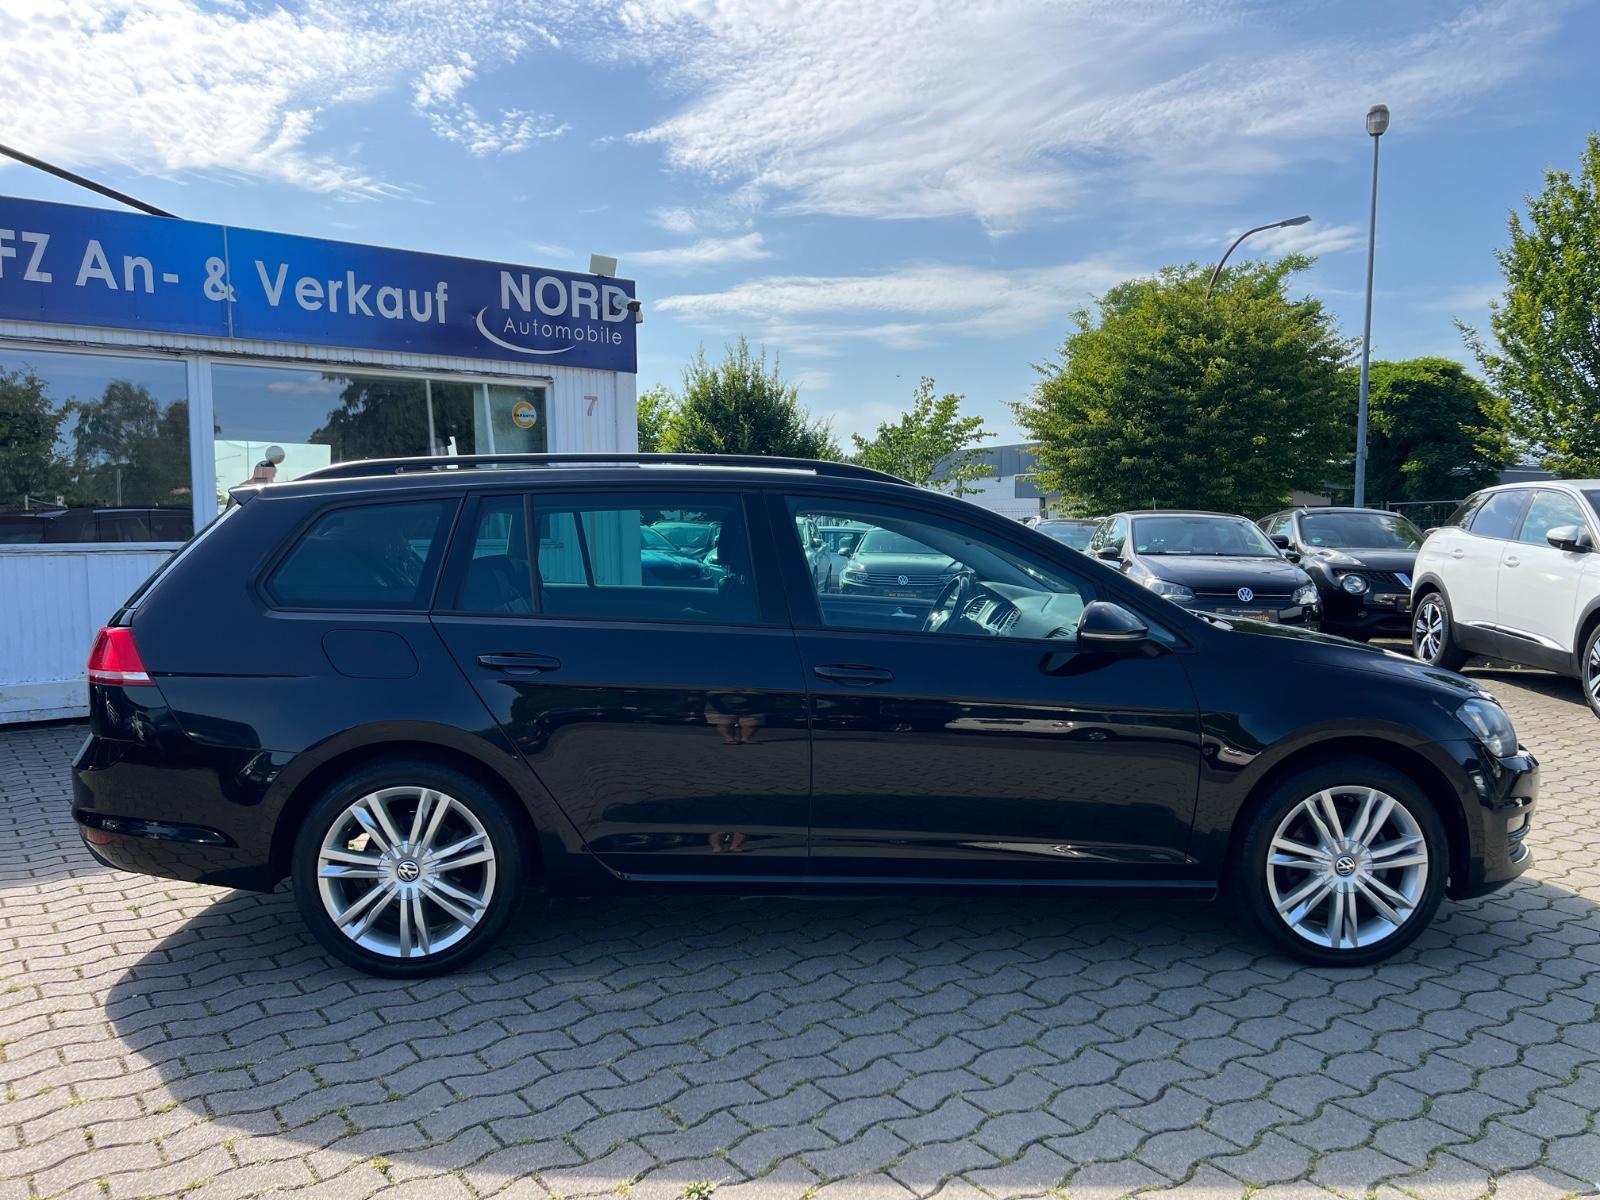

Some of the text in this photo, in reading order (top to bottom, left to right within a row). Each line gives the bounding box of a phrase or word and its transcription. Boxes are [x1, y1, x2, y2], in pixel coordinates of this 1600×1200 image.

[75, 239, 179, 294] An-
[203, 256, 237, 303] &
[254, 260, 448, 323] Verkauf
[500, 271, 629, 323] NORD
[503, 317, 623, 345] Automobile
[583, 396, 598, 416] 7
